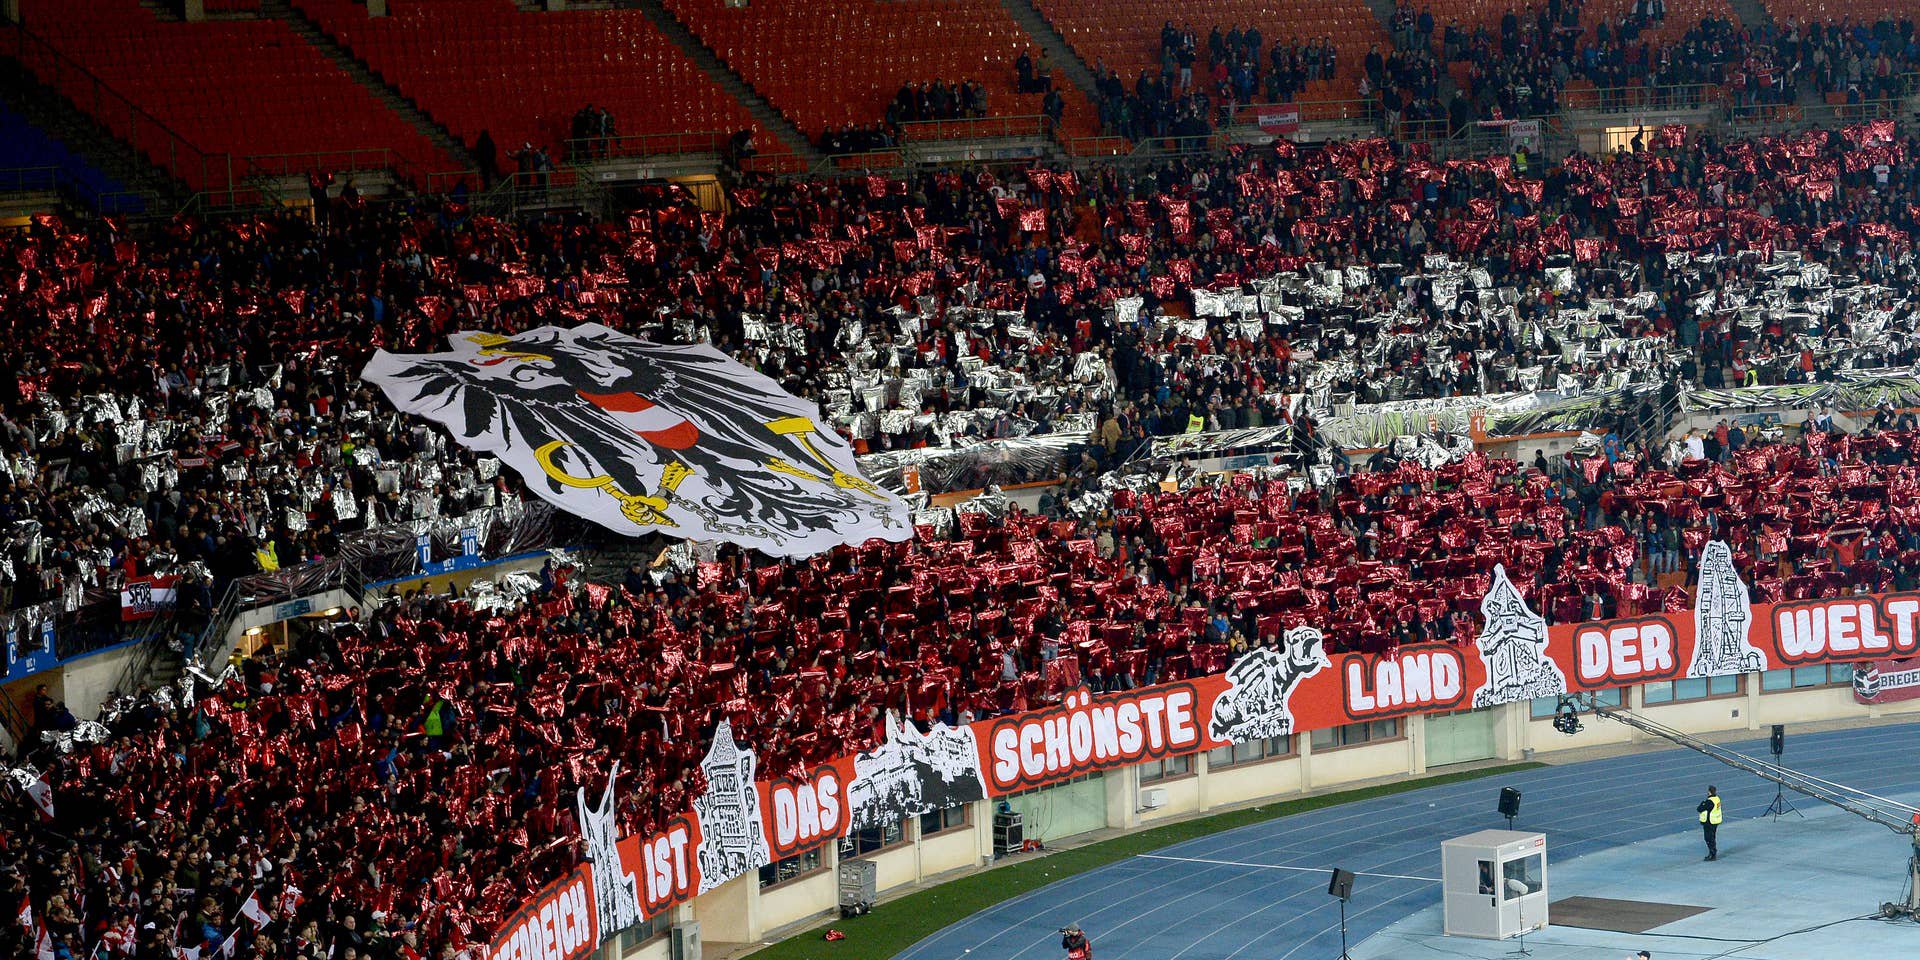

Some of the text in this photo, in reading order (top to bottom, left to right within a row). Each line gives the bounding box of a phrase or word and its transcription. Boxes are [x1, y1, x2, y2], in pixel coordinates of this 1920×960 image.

[1512, 124, 1537, 132] POLSKA
[423, 546, 430, 563] D
[463, 538, 475, 556] 10
[43, 633, 49, 653] 9
[10, 644, 16, 664] C
[643, 828, 688, 903] IST
[774, 775, 840, 846] DAS
[994, 691, 1195, 782] SCHÖNSTE
[1348, 653, 1461, 711] LAND
[1580, 624, 1672, 679] DER
[1779, 601, 1919, 656] WELT
